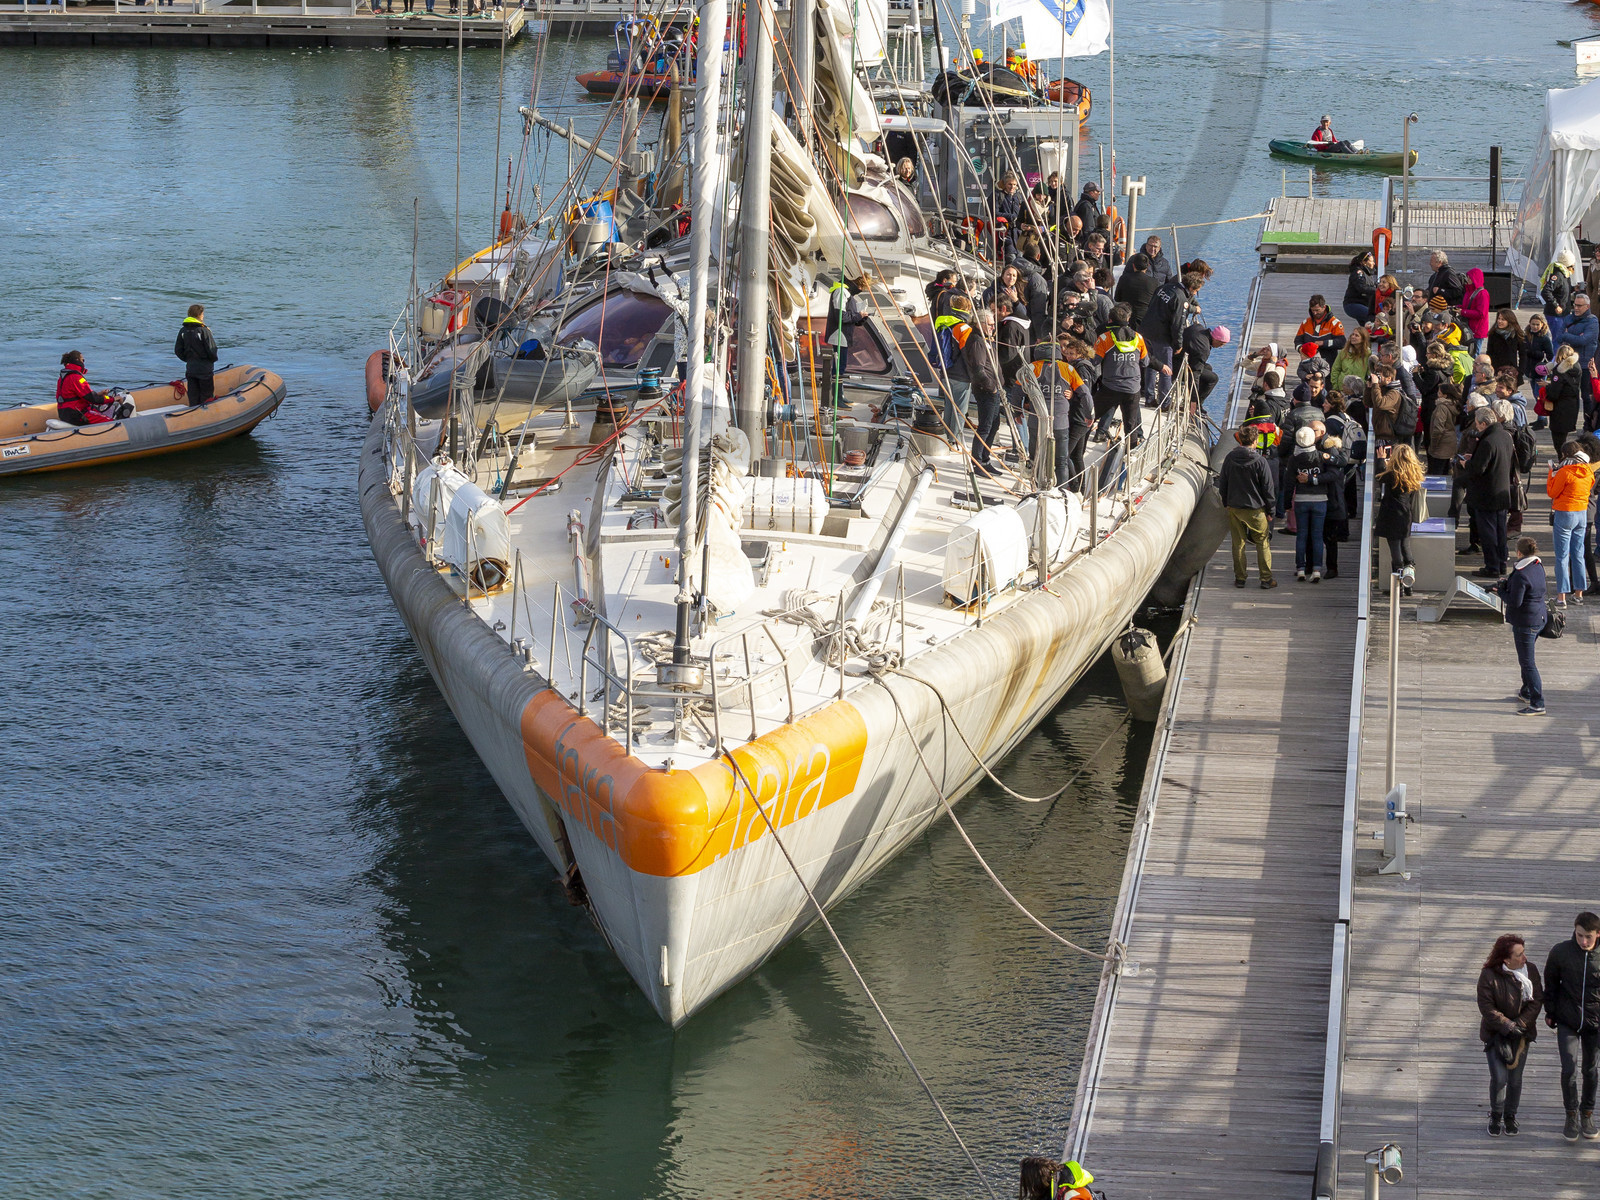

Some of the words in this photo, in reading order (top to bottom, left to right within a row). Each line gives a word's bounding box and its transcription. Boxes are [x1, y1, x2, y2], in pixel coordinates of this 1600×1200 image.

[1113, 351, 1136, 362] tara
[1039, 382, 1063, 394] taa
[720, 743, 831, 852] tara
